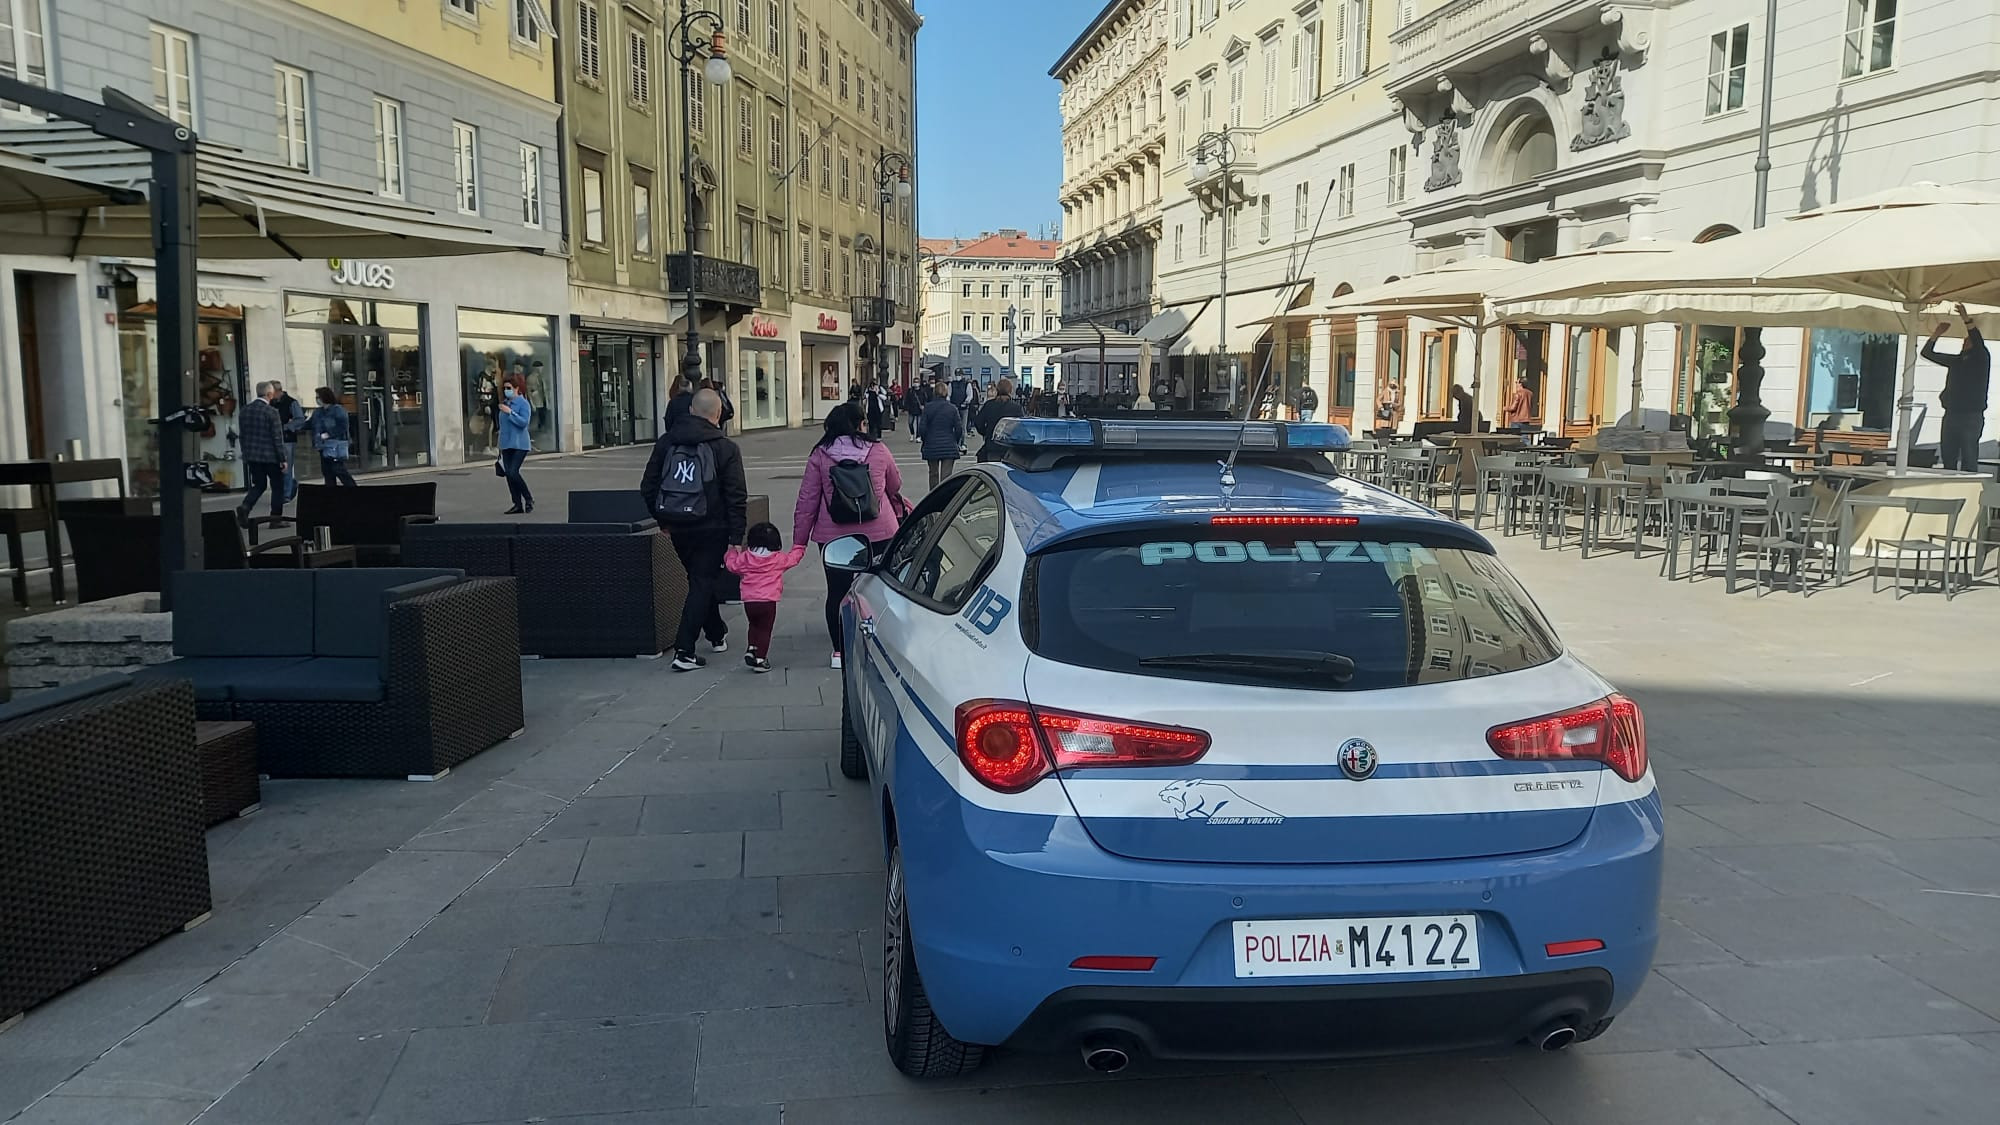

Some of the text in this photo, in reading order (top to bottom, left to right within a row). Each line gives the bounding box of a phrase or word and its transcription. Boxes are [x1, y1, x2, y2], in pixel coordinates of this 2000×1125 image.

[1140, 540, 1438, 566] POLIZIA
[962, 584, 1012, 635] 113
[1206, 817, 1285, 825] SQUADRA VOLANTE
[1245, 922, 1470, 968] POLIZIA M4122
